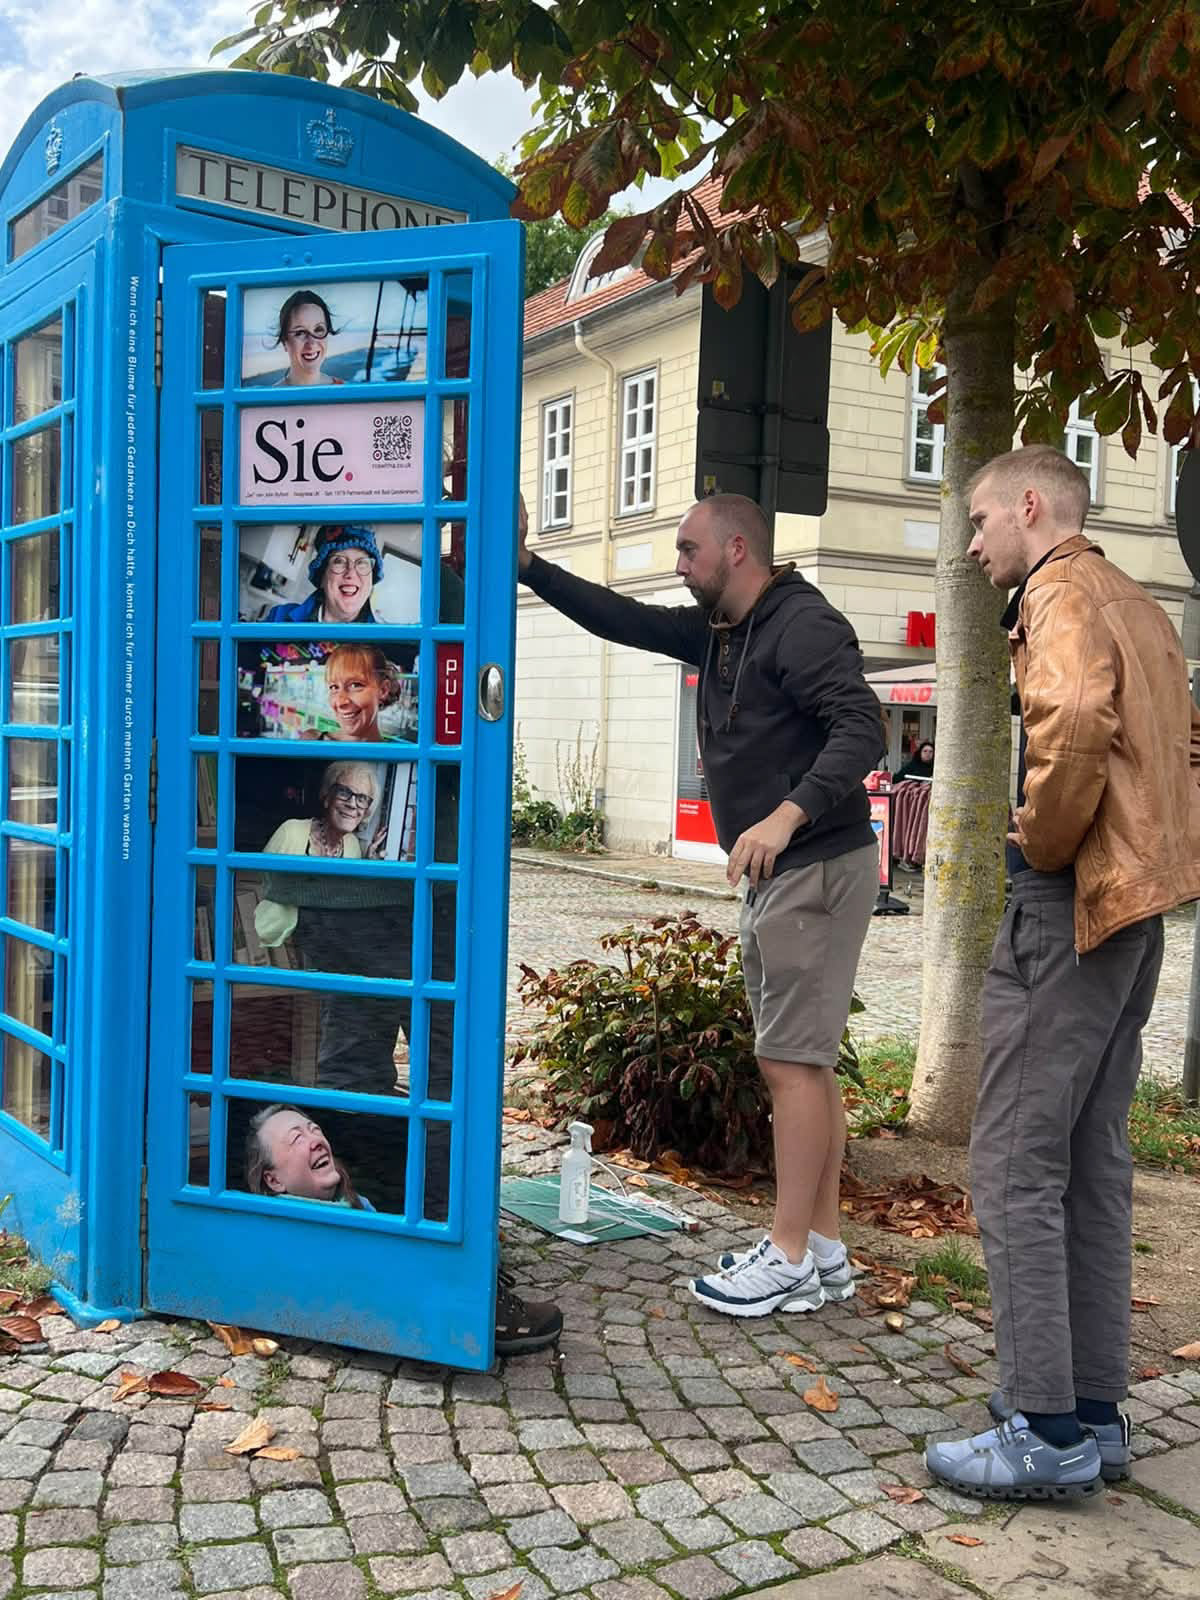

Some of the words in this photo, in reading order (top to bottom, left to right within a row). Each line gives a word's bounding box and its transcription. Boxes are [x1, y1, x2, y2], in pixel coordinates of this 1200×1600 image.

[181, 154, 456, 232] TELEPHON
[130, 275, 139, 306] Wenn
[128, 309, 138, 326] ich
[128, 328, 137, 353] eine
[127, 356, 137, 391] Blume
[126, 410, 137, 443] jeden
[252, 418, 353, 485] Sie.
[127, 446, 137, 501] Gedanken
[127, 504, 134, 518] an
[127, 520, 137, 545] Dich
[125, 622, 135, 640] ich
[906, 611, 936, 648] N
[125, 660, 134, 695] immer
[890, 686, 932, 703] NKD
[124, 697, 134, 729] durch
[445, 659, 457, 735] PULL
[123, 731, 133, 770] meinen
[123, 773, 133, 810] Garten
[122, 813, 131, 860] wandern
